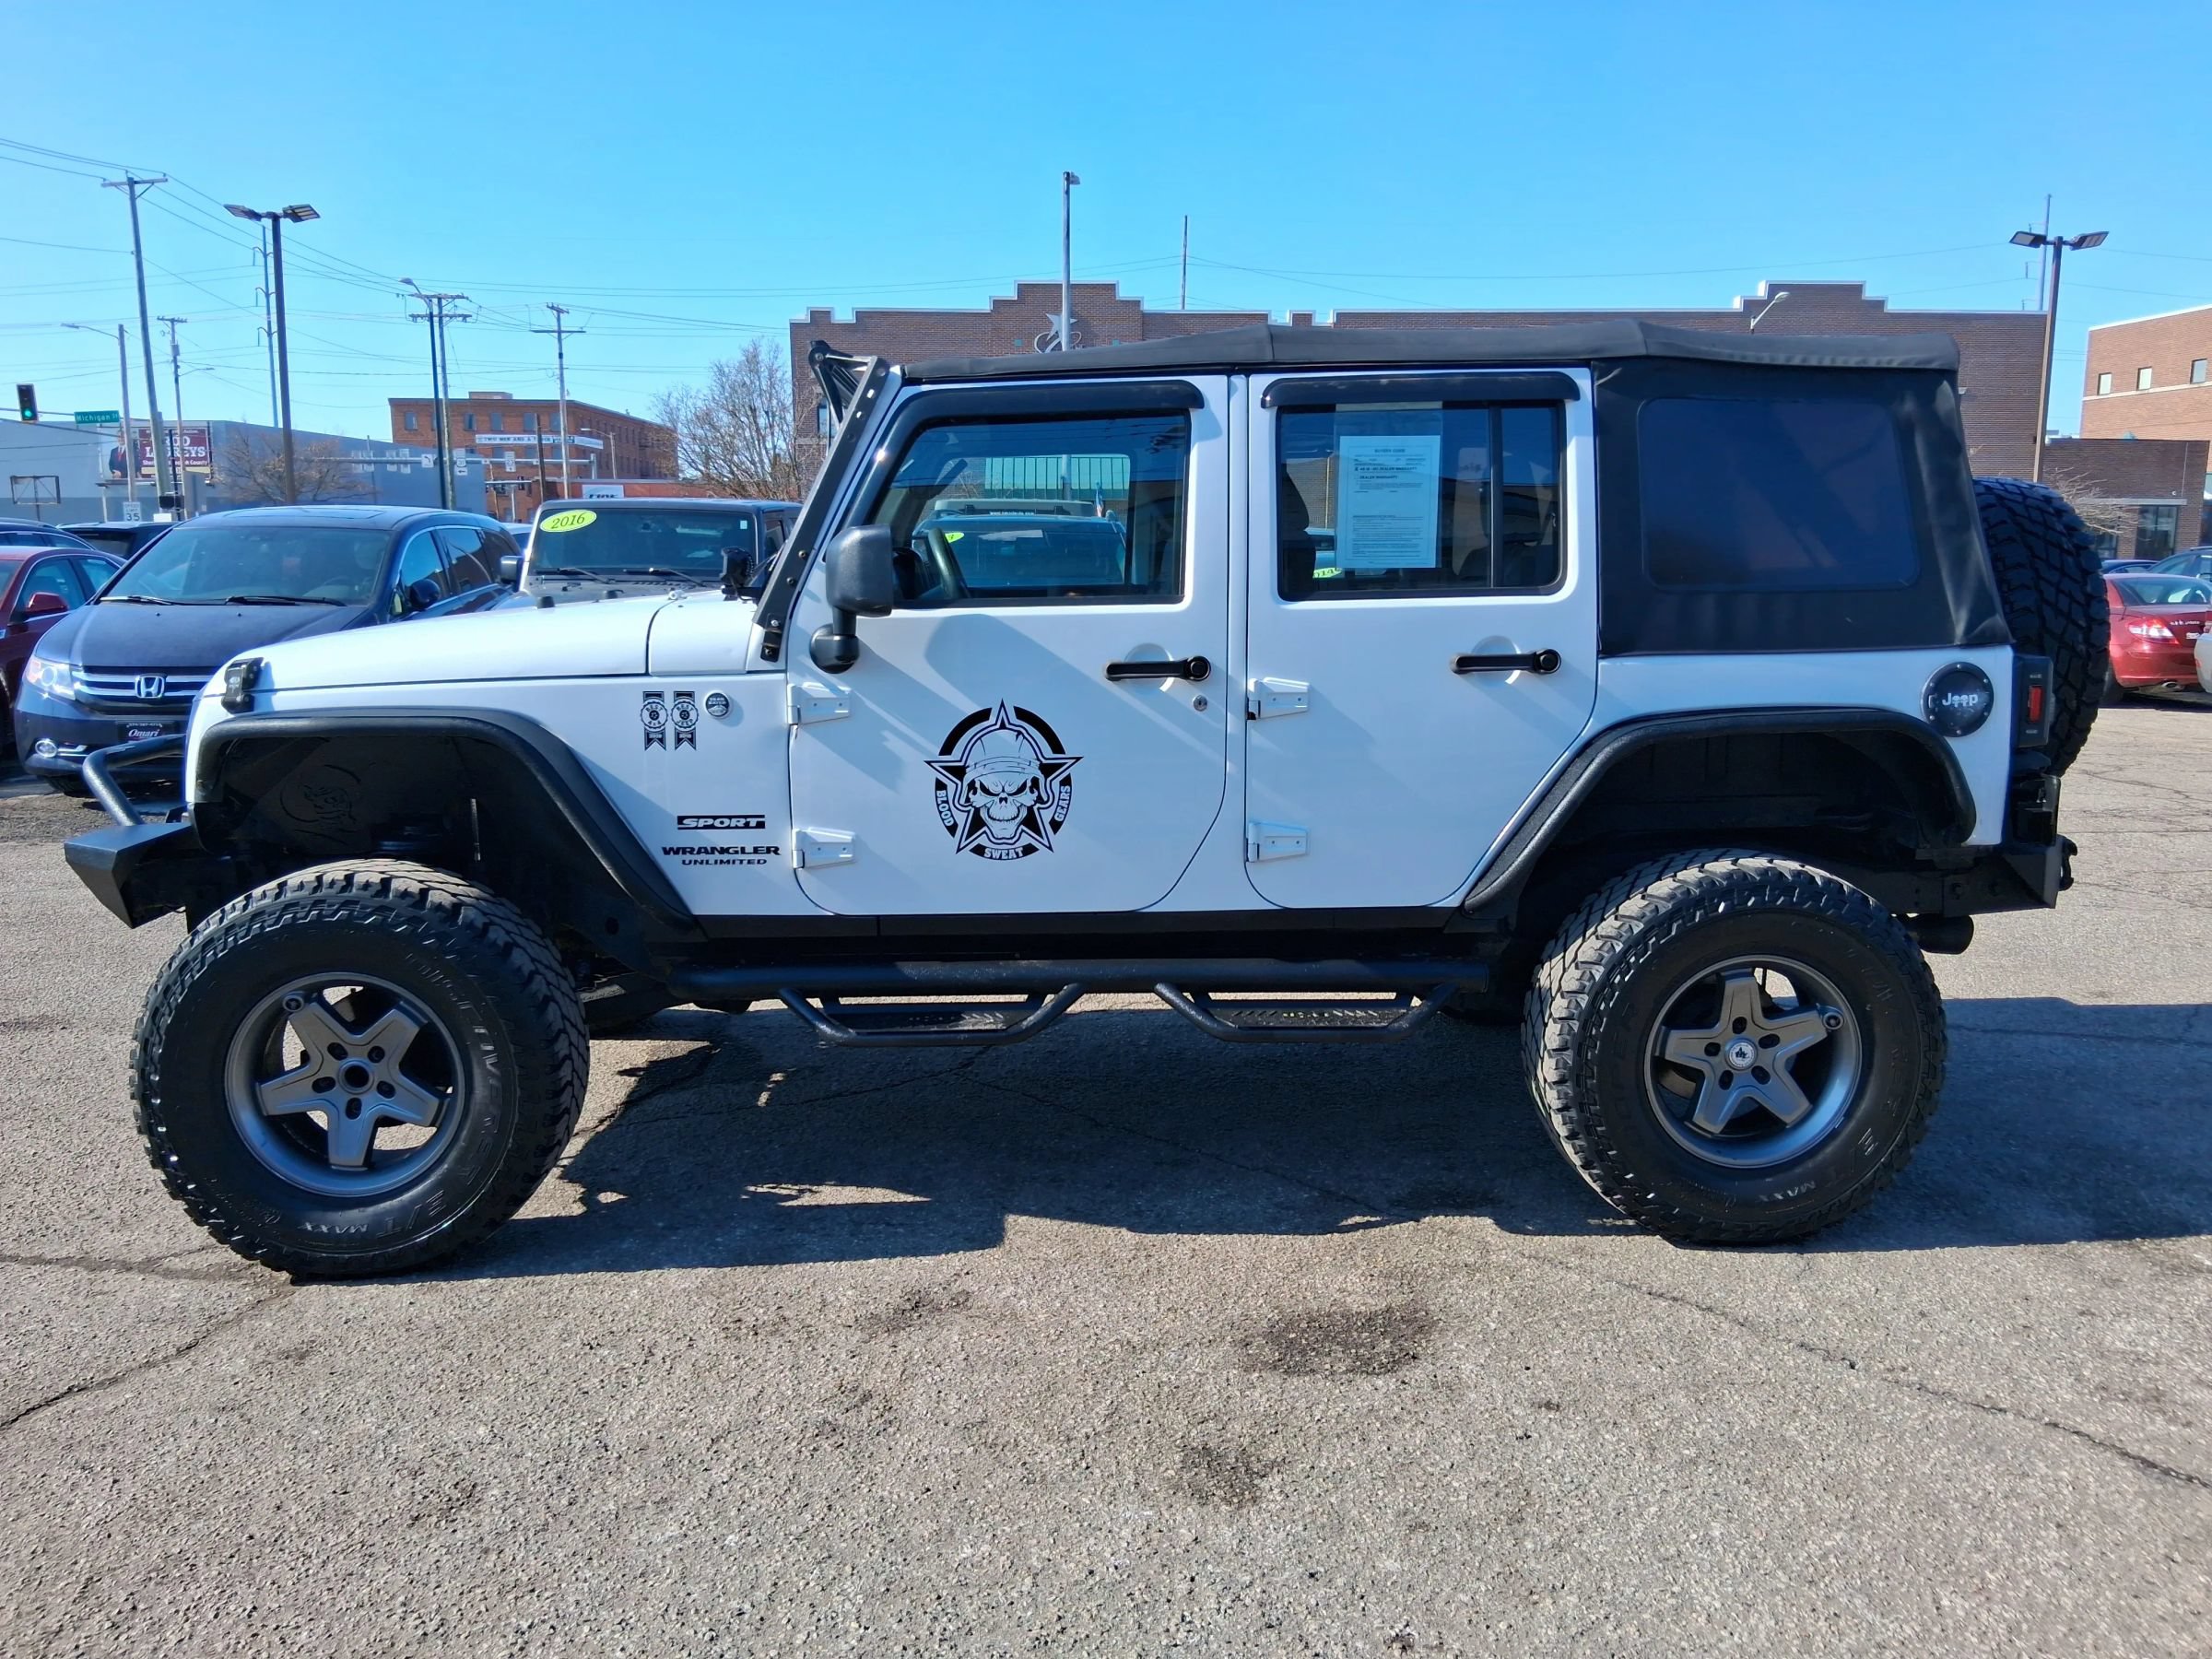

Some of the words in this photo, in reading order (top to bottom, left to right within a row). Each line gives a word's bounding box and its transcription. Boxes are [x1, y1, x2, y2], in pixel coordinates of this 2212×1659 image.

[76, 412, 111, 423] Michigan
[125, 512, 140, 522] 35
[551, 512, 586, 530] 2016
[1941, 692, 1979, 708] Jeep
[677, 718, 694, 726] JEEP
[128, 728, 160, 737] Omari
[935, 790, 955, 827] BLOOD
[1054, 785, 1072, 821] GEARS
[679, 818, 764, 828] SPORT
[662, 845, 782, 855] WRANGLER
[983, 847, 1024, 860] SWEAT
[297, 1221, 370, 1234] MAXX
